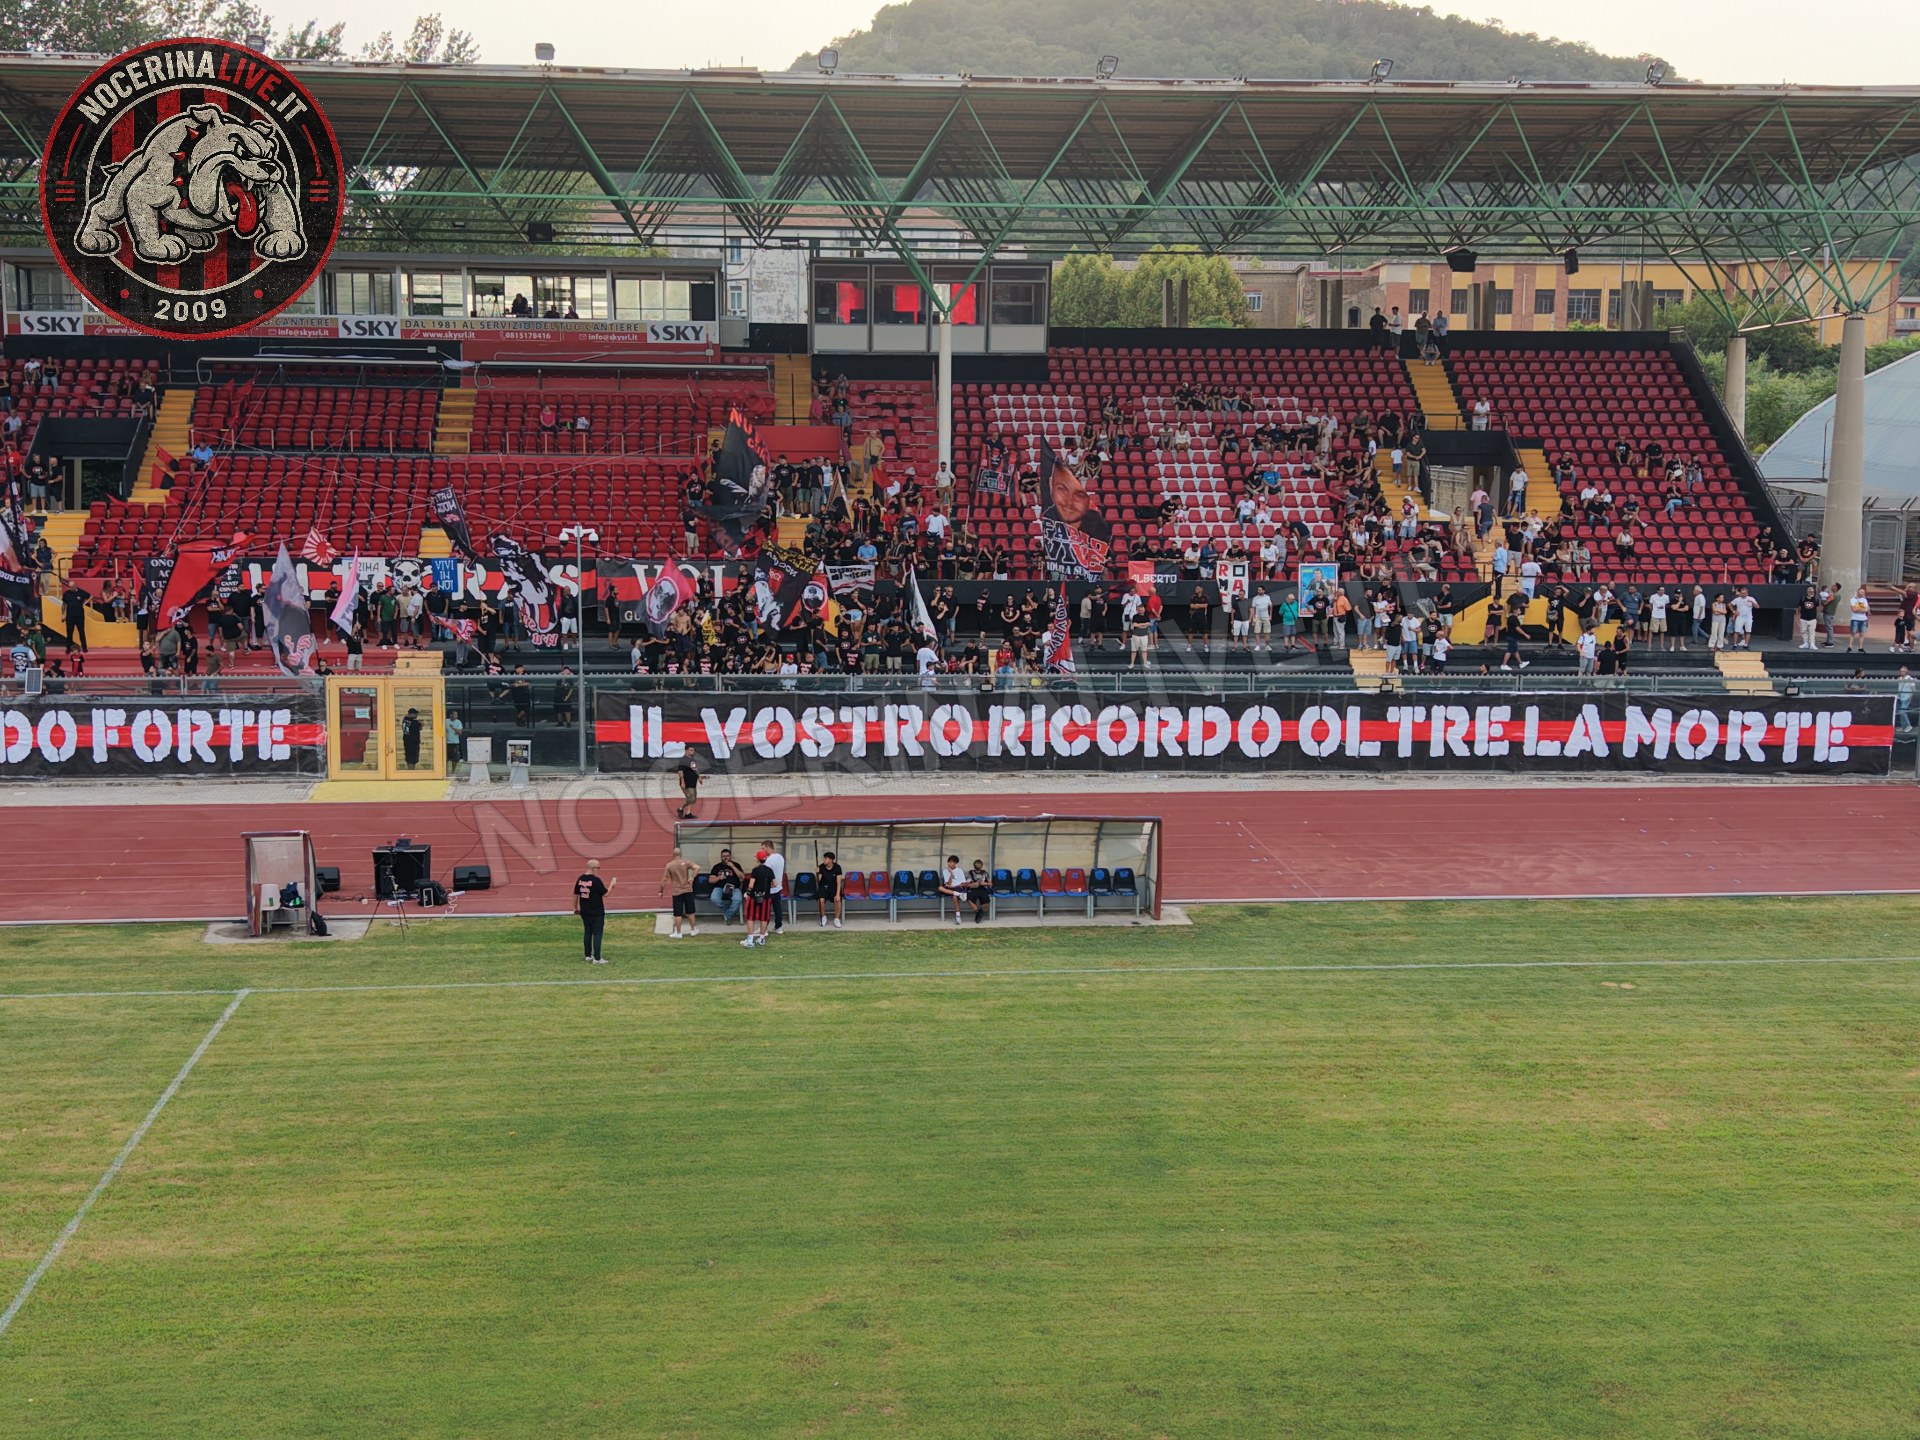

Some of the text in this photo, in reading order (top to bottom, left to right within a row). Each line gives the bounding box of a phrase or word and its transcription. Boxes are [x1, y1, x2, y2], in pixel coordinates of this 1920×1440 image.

[37, 316, 80, 333] SKY
[88, 315, 109, 324] DAL
[354, 320, 398, 337] SKY
[405, 320, 639, 332] DAL 1981 AL SERVIZIO DEL TUO CANTIERE
[422, 330, 475, 339] www.skysrl.it
[662, 325, 704, 341] SKY
[434, 560, 455, 571] VIVI
[440, 570, 451, 580] IN
[1131, 573, 1178, 584] ALBERTO
[91, 708, 292, 764] FORTE
[629, 703, 1853, 764] IL VOSTRO RICORDO OLTRE LA MORTE
